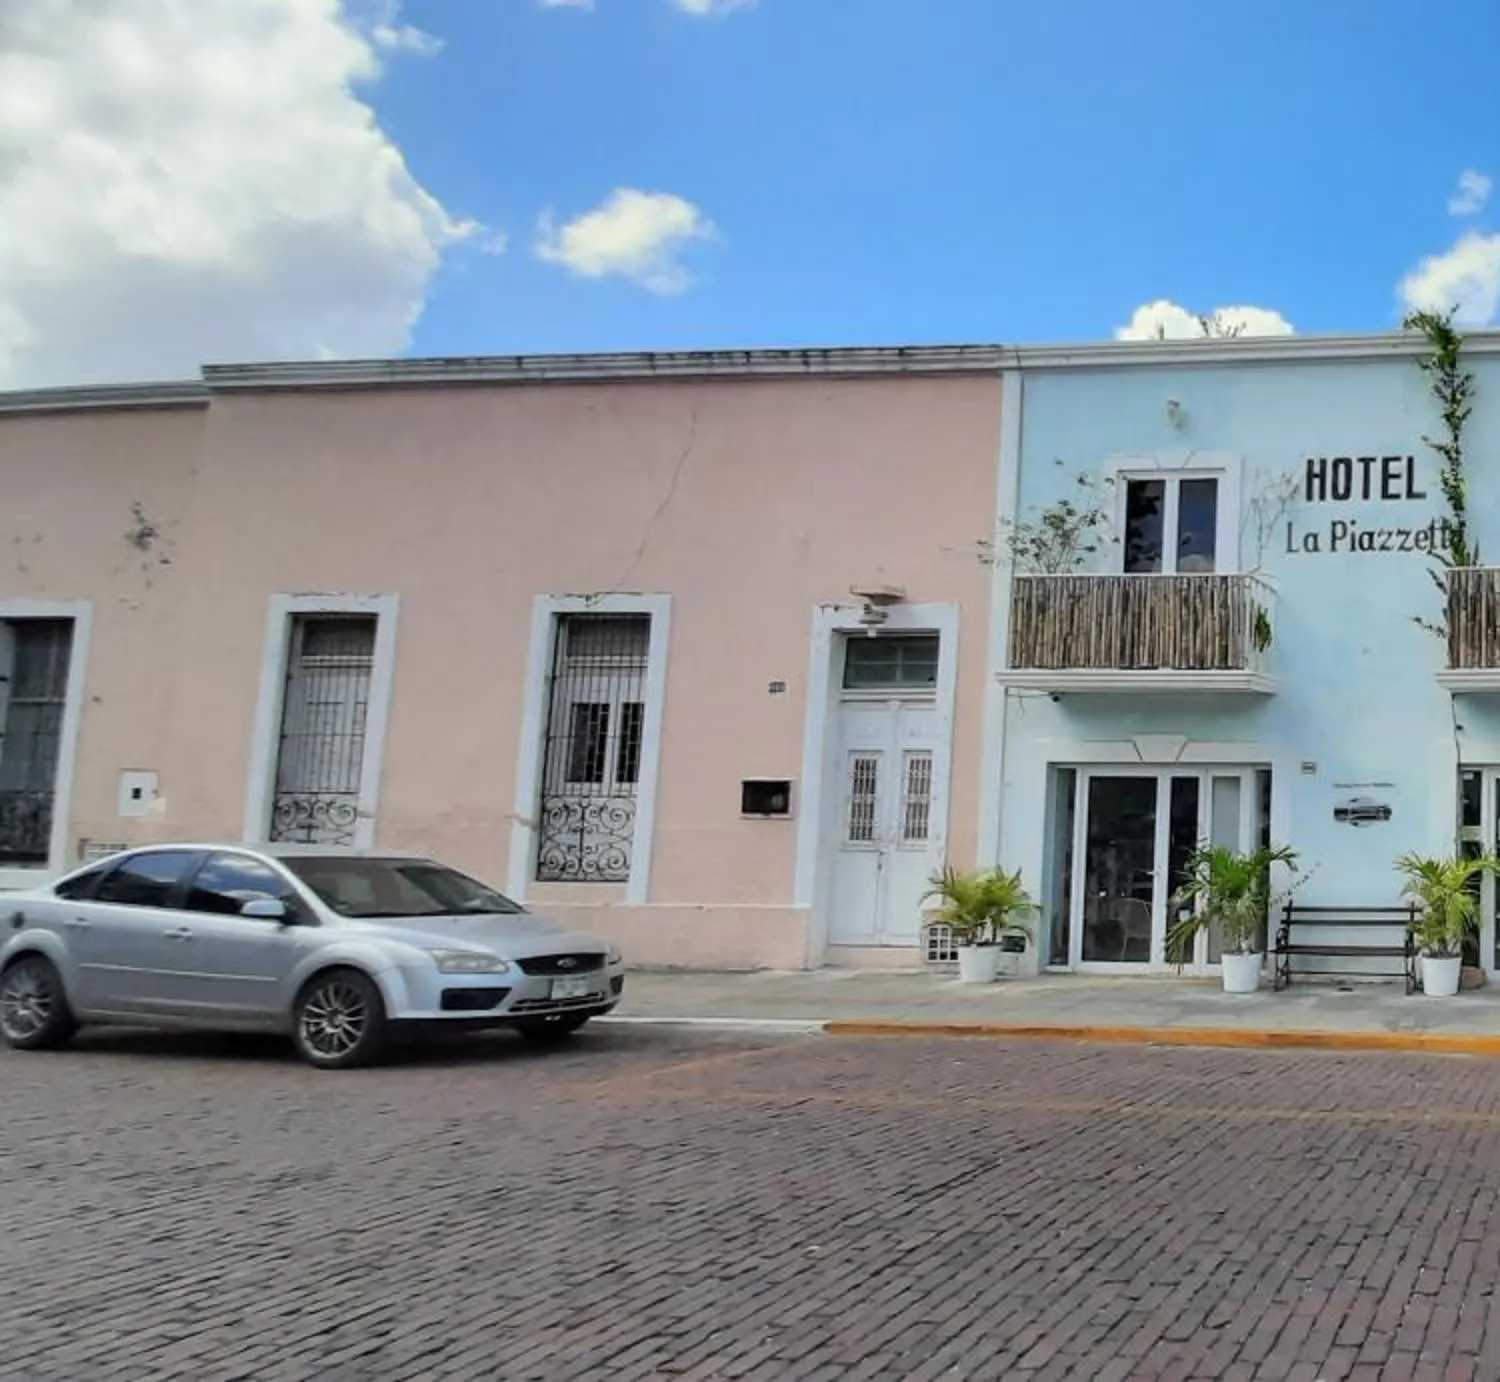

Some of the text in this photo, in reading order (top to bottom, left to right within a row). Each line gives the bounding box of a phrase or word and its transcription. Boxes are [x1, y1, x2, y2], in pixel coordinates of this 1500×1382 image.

[1305, 455, 1427, 502] HOTEL
[1286, 515, 1465, 553] La Piazzett
